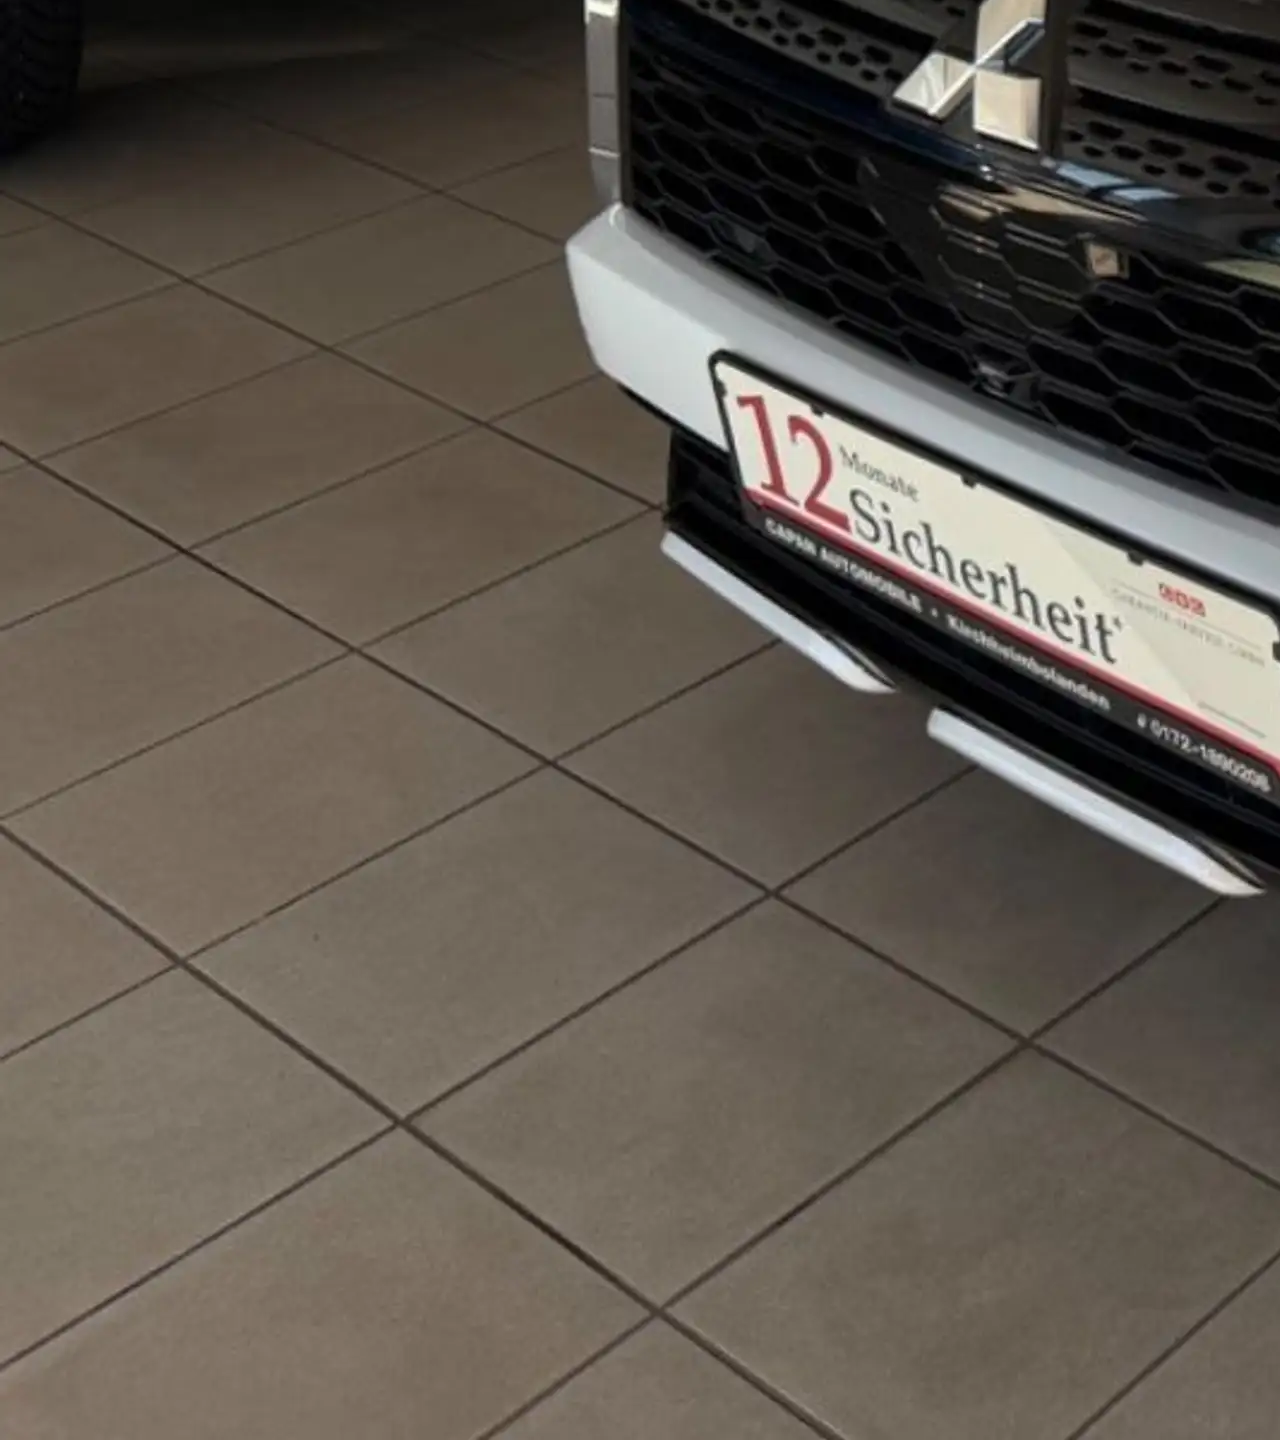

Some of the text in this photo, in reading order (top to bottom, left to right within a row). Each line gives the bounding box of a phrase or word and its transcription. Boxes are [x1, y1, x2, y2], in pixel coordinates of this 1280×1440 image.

[737, 394, 851, 534] 12
[838, 443, 920, 502] Monate
[764, 517, 818, 557] CAPAN
